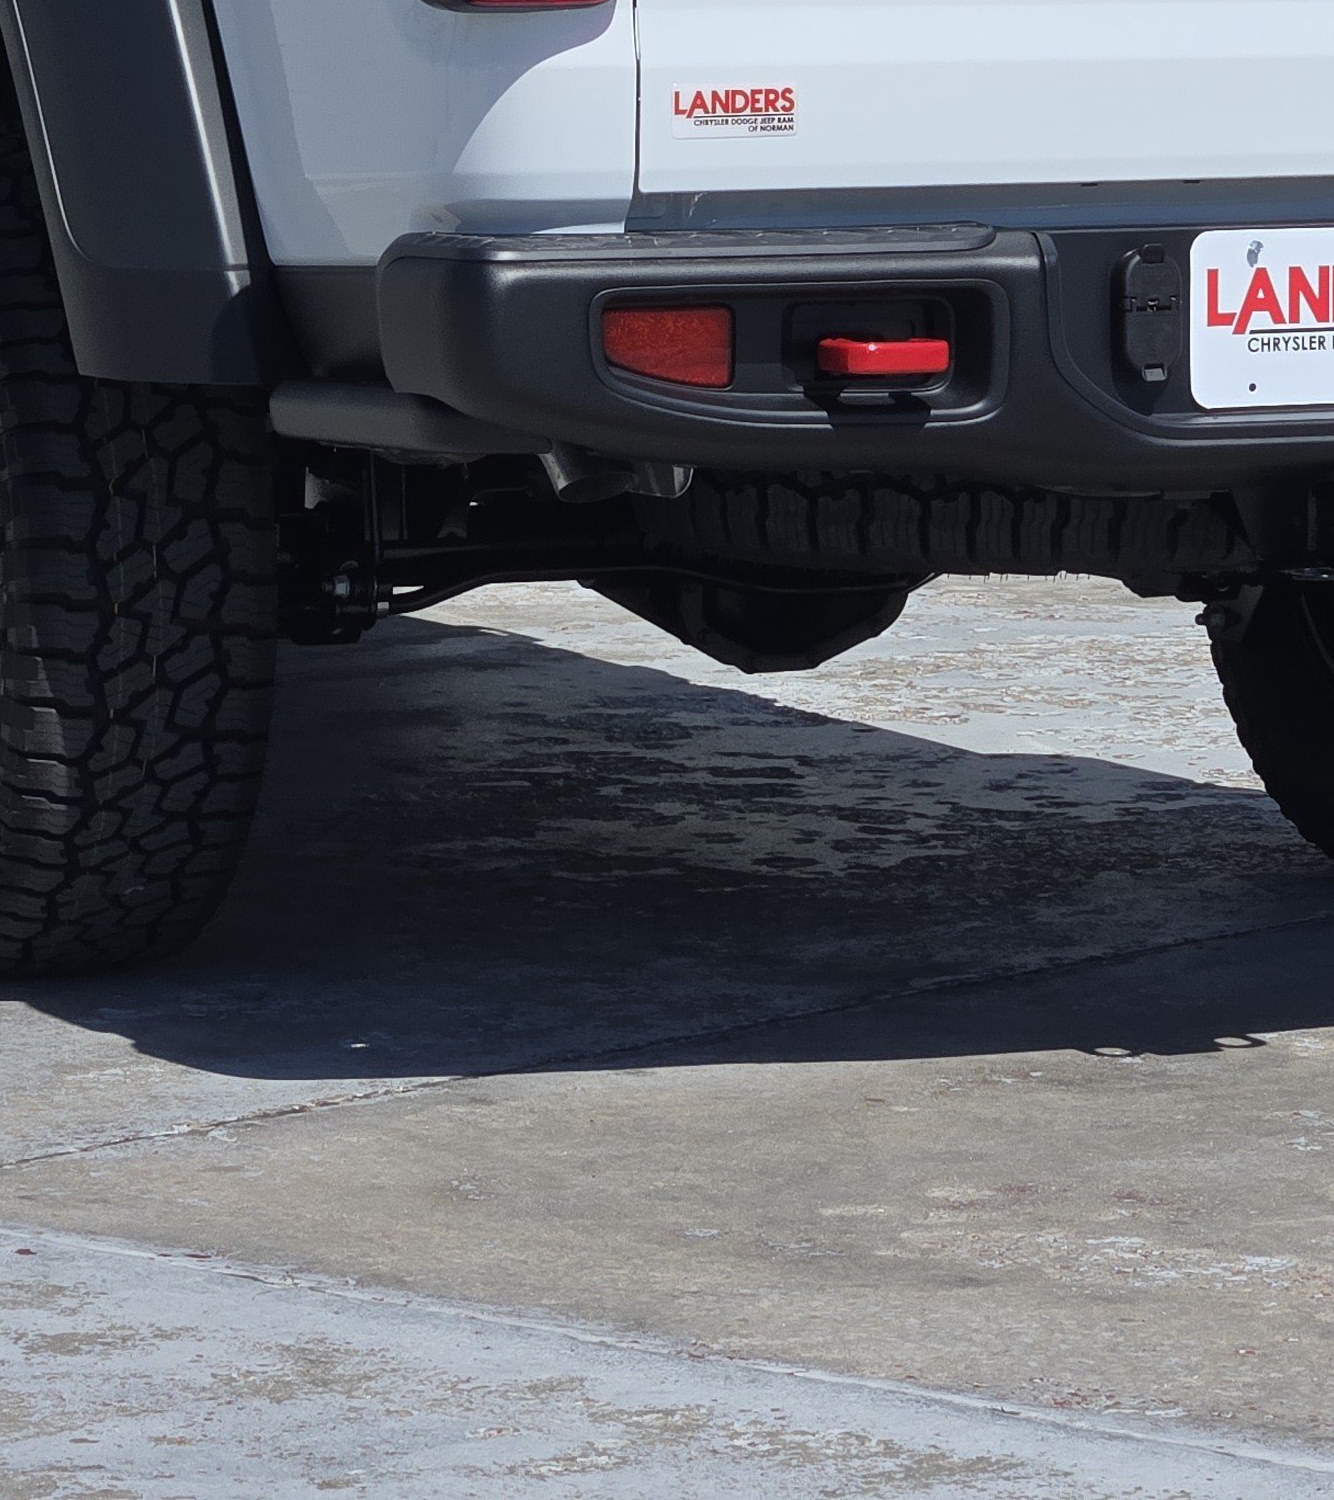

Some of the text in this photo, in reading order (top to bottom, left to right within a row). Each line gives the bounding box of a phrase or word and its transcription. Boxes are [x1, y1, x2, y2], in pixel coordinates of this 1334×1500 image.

[674, 88, 794, 118] LANDERS
[693, 118, 729, 127] CHRYSLER
[731, 117, 757, 125] DODGE
[777, 116, 794, 124] RAM
[760, 124, 794, 132] NORMAN
[1247, 335, 1326, 353] CHRYSLER
